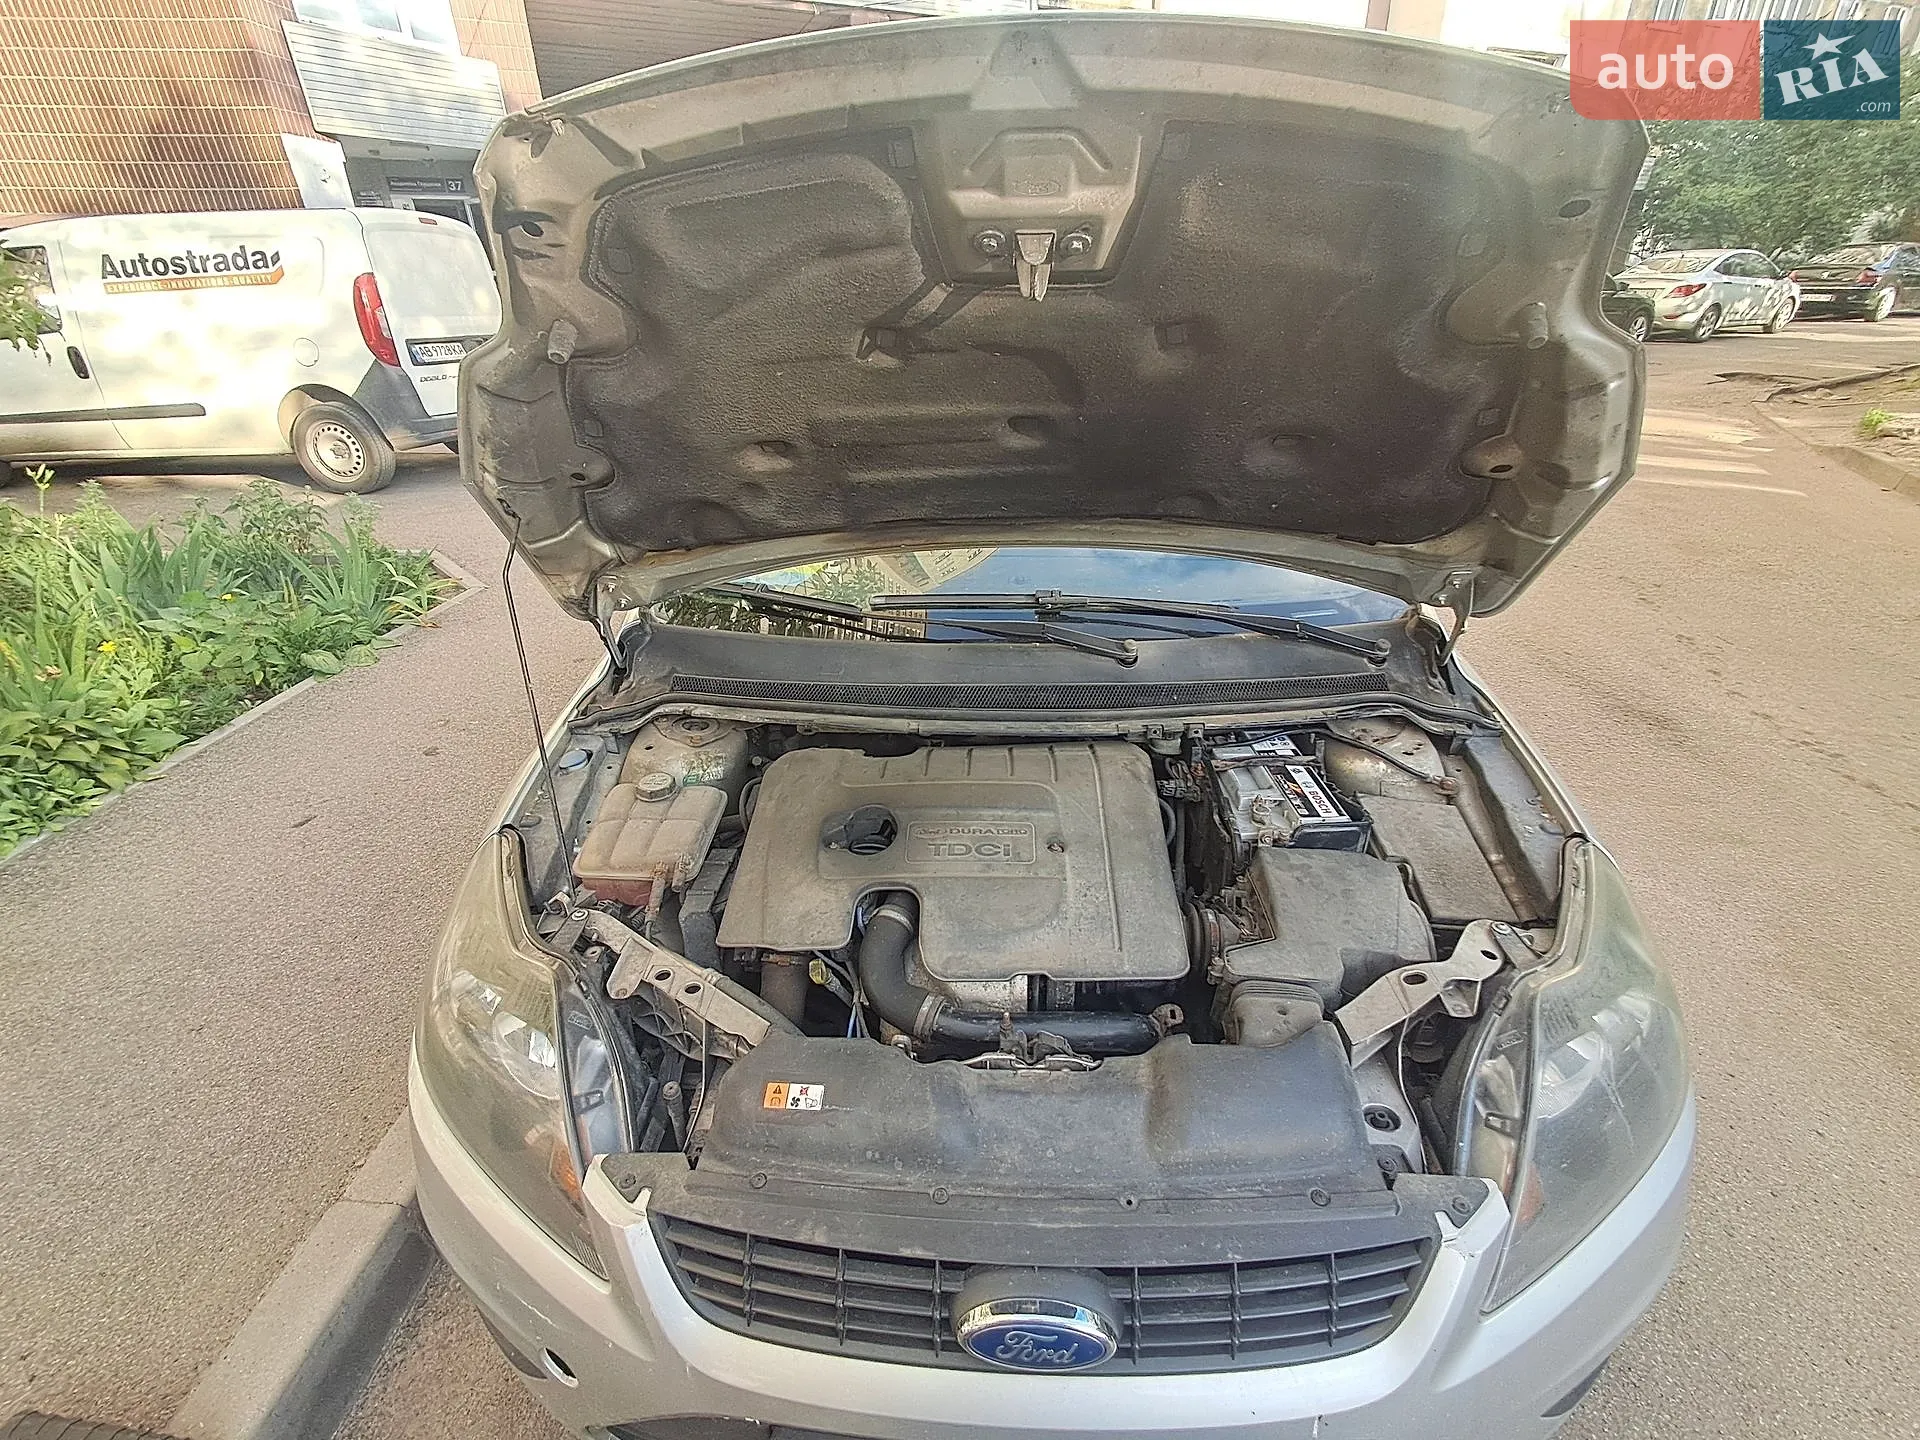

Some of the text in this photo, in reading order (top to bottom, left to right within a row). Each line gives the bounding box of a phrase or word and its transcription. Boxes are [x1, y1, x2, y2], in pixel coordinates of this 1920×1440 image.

[447, 181, 461, 191] 37
[101, 245, 270, 279] Autostrada
[1308, 790, 1332, 814] BOSCH
[927, 842, 1011, 857] TDCi
[996, 1331, 1080, 1363] Ford
